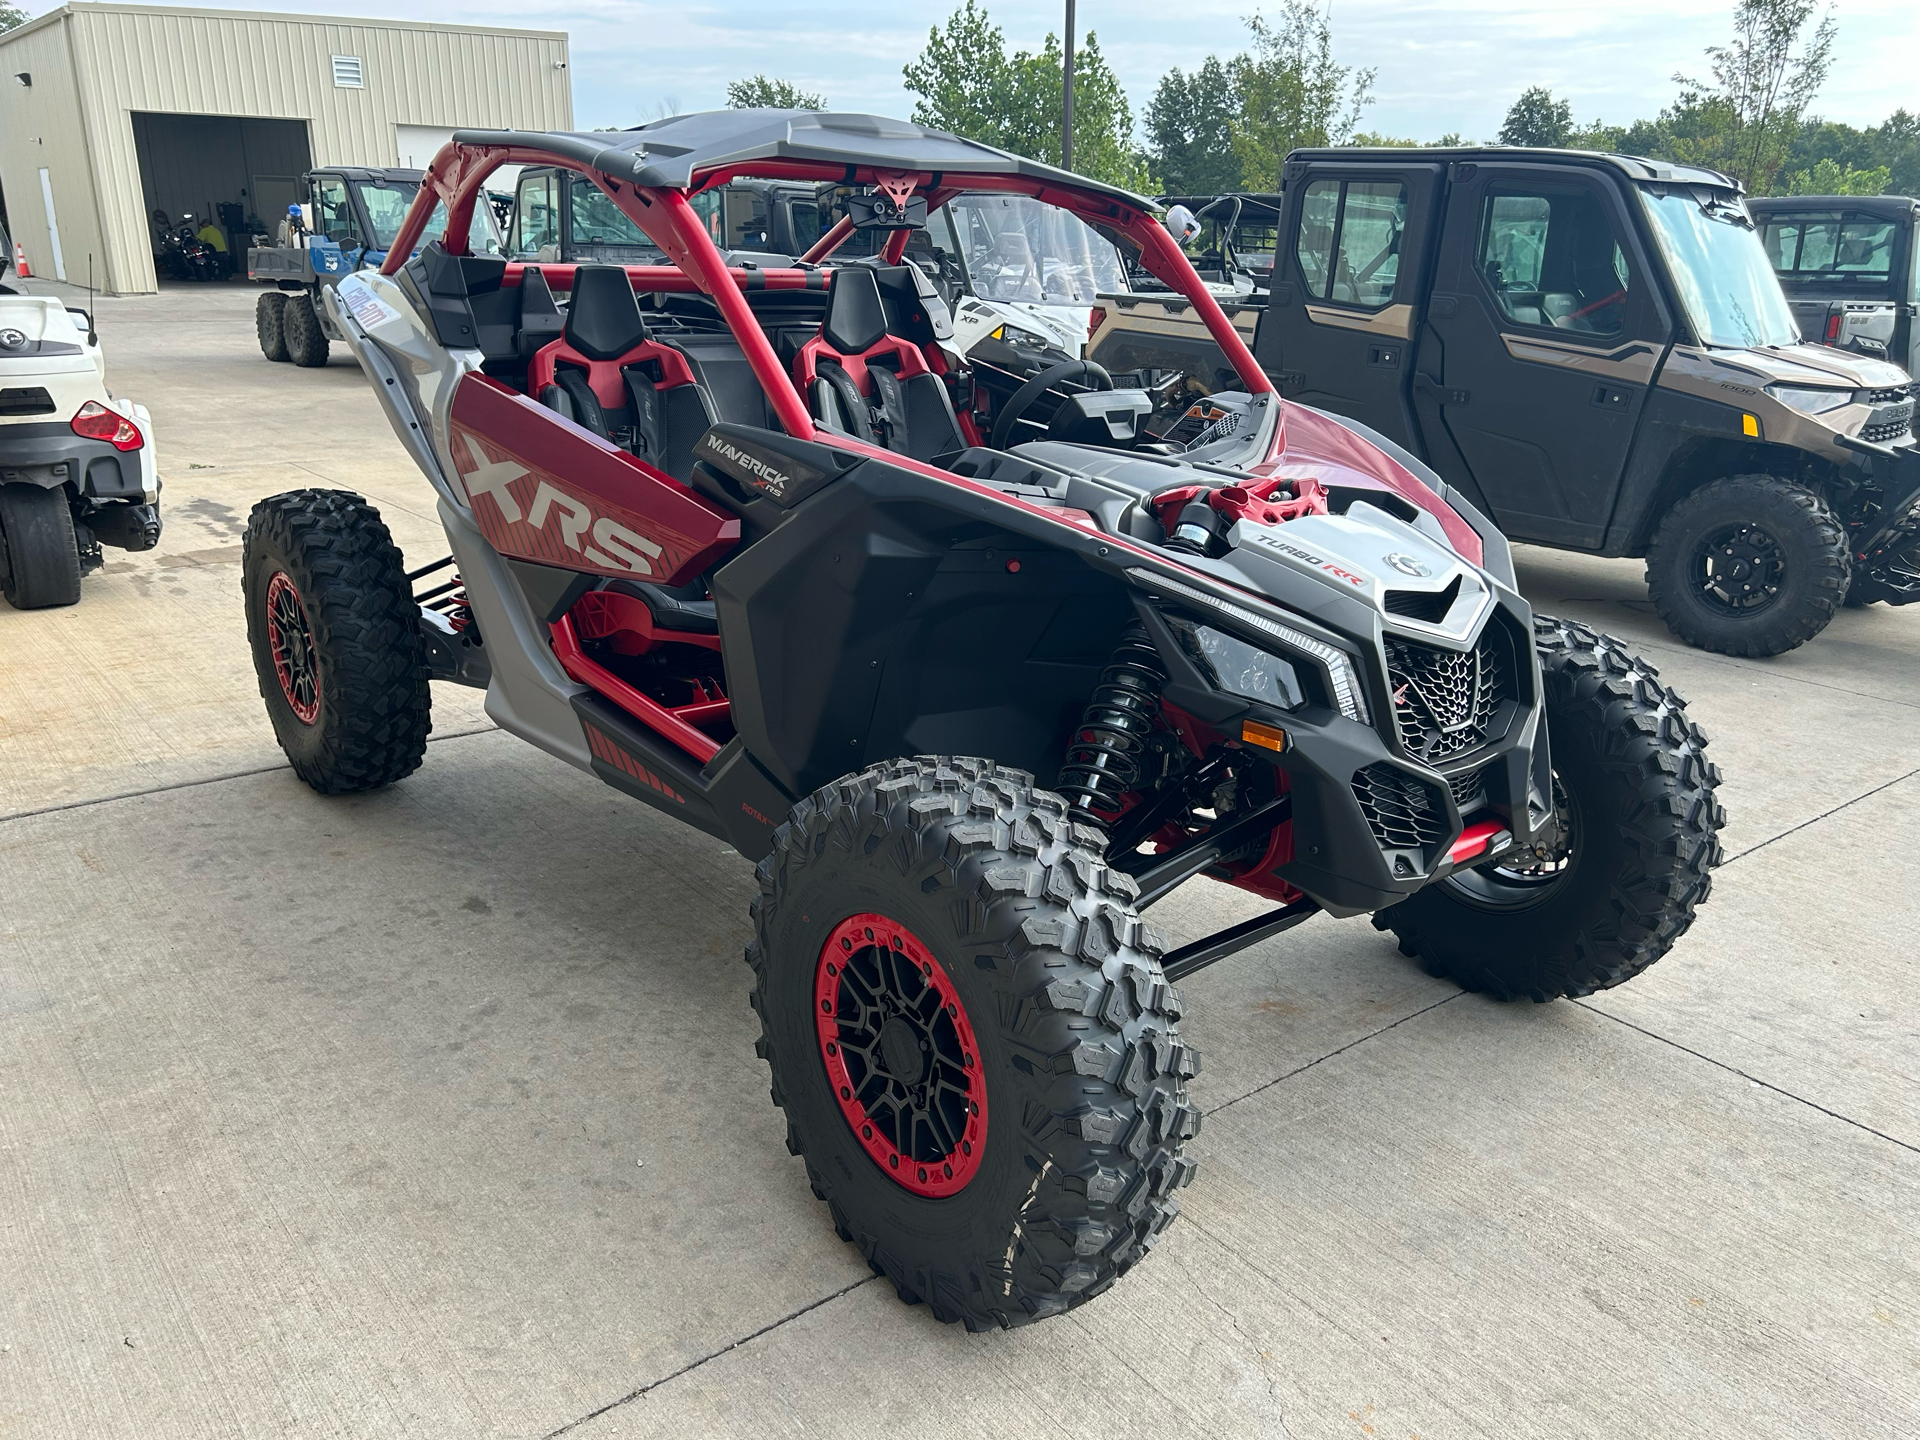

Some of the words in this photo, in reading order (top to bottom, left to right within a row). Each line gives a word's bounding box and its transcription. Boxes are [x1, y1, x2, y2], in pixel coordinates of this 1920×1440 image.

[961, 314, 979, 324] XP
[1720, 383, 1757, 397] 1000
[707, 434, 790, 490] MAVERICK
[752, 475, 783, 498] XRS
[461, 432, 663, 576] XRS
[1257, 534, 1324, 565] TURBO
[1322, 564, 1364, 586] RR
[742, 802, 768, 825] ROTAX
